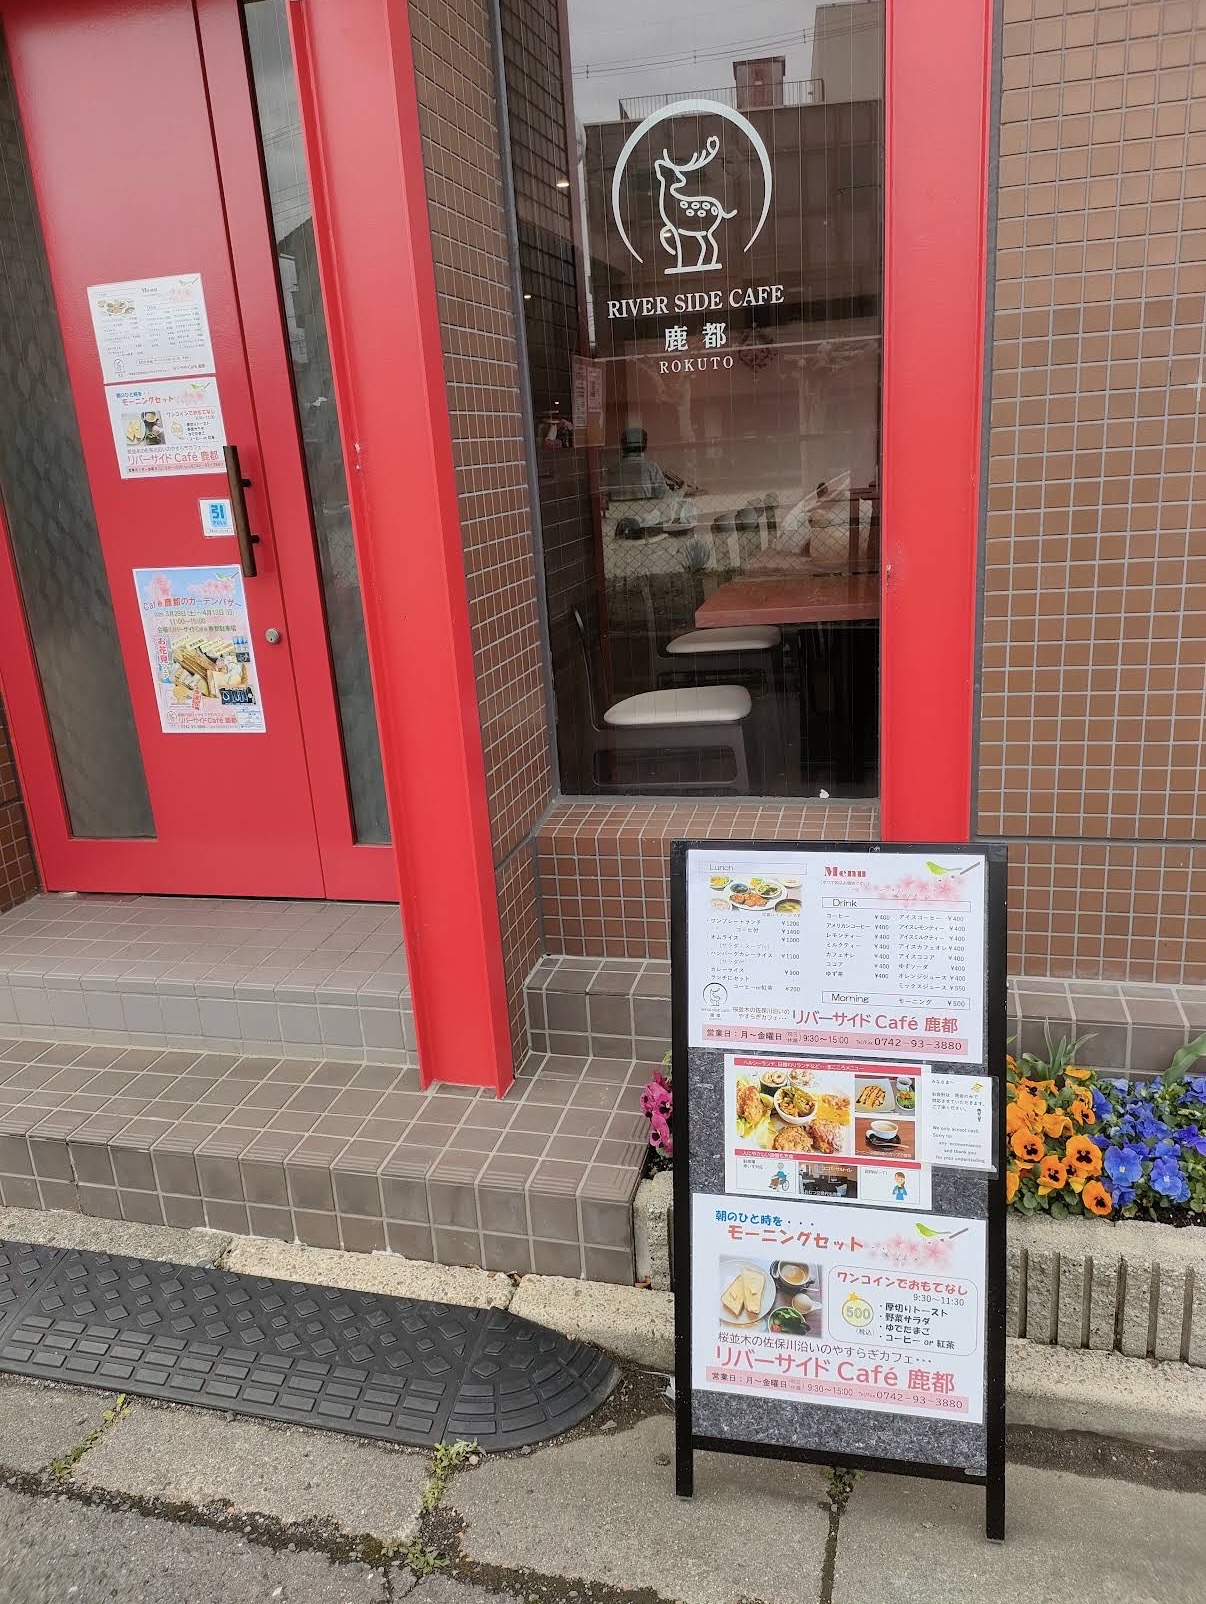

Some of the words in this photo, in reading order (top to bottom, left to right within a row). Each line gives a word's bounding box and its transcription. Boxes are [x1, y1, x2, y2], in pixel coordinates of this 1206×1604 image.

[607, 296, 670, 319] RIVER
[674, 291, 724, 313] SIDE
[729, 285, 785, 308] CAFE
[664, 322, 727, 352] 鹿都
[659, 355, 734, 374] ROKUTO
[127, 453, 173, 466] リバーサイド
[709, 863, 734, 871] Lunch
[824, 866, 867, 878] Menu
[832, 898, 857, 908] Drink
[831, 993, 870, 1003] Morning
[792, 1010, 871, 1029] リバーサイド
[875, 1014, 919, 1031] Café
[924, 1016, 958, 1034] 鹿都
[874, 1037, 962, 1051] 0742-93-3880
[728, 1224, 864, 1252] モーニングセット
[837, 1271, 968, 1296] ワンコインでおもてなし
[846, 1306, 871, 1320] 500
[936, 1340, 956, 1350] 紅茶
[716, 1345, 831, 1378] リバーサイド
[837, 1361, 899, 1387] Café
[907, 1368, 955, 1395] 鹿都
[876, 1391, 963, 1409] 0742-93-3880
